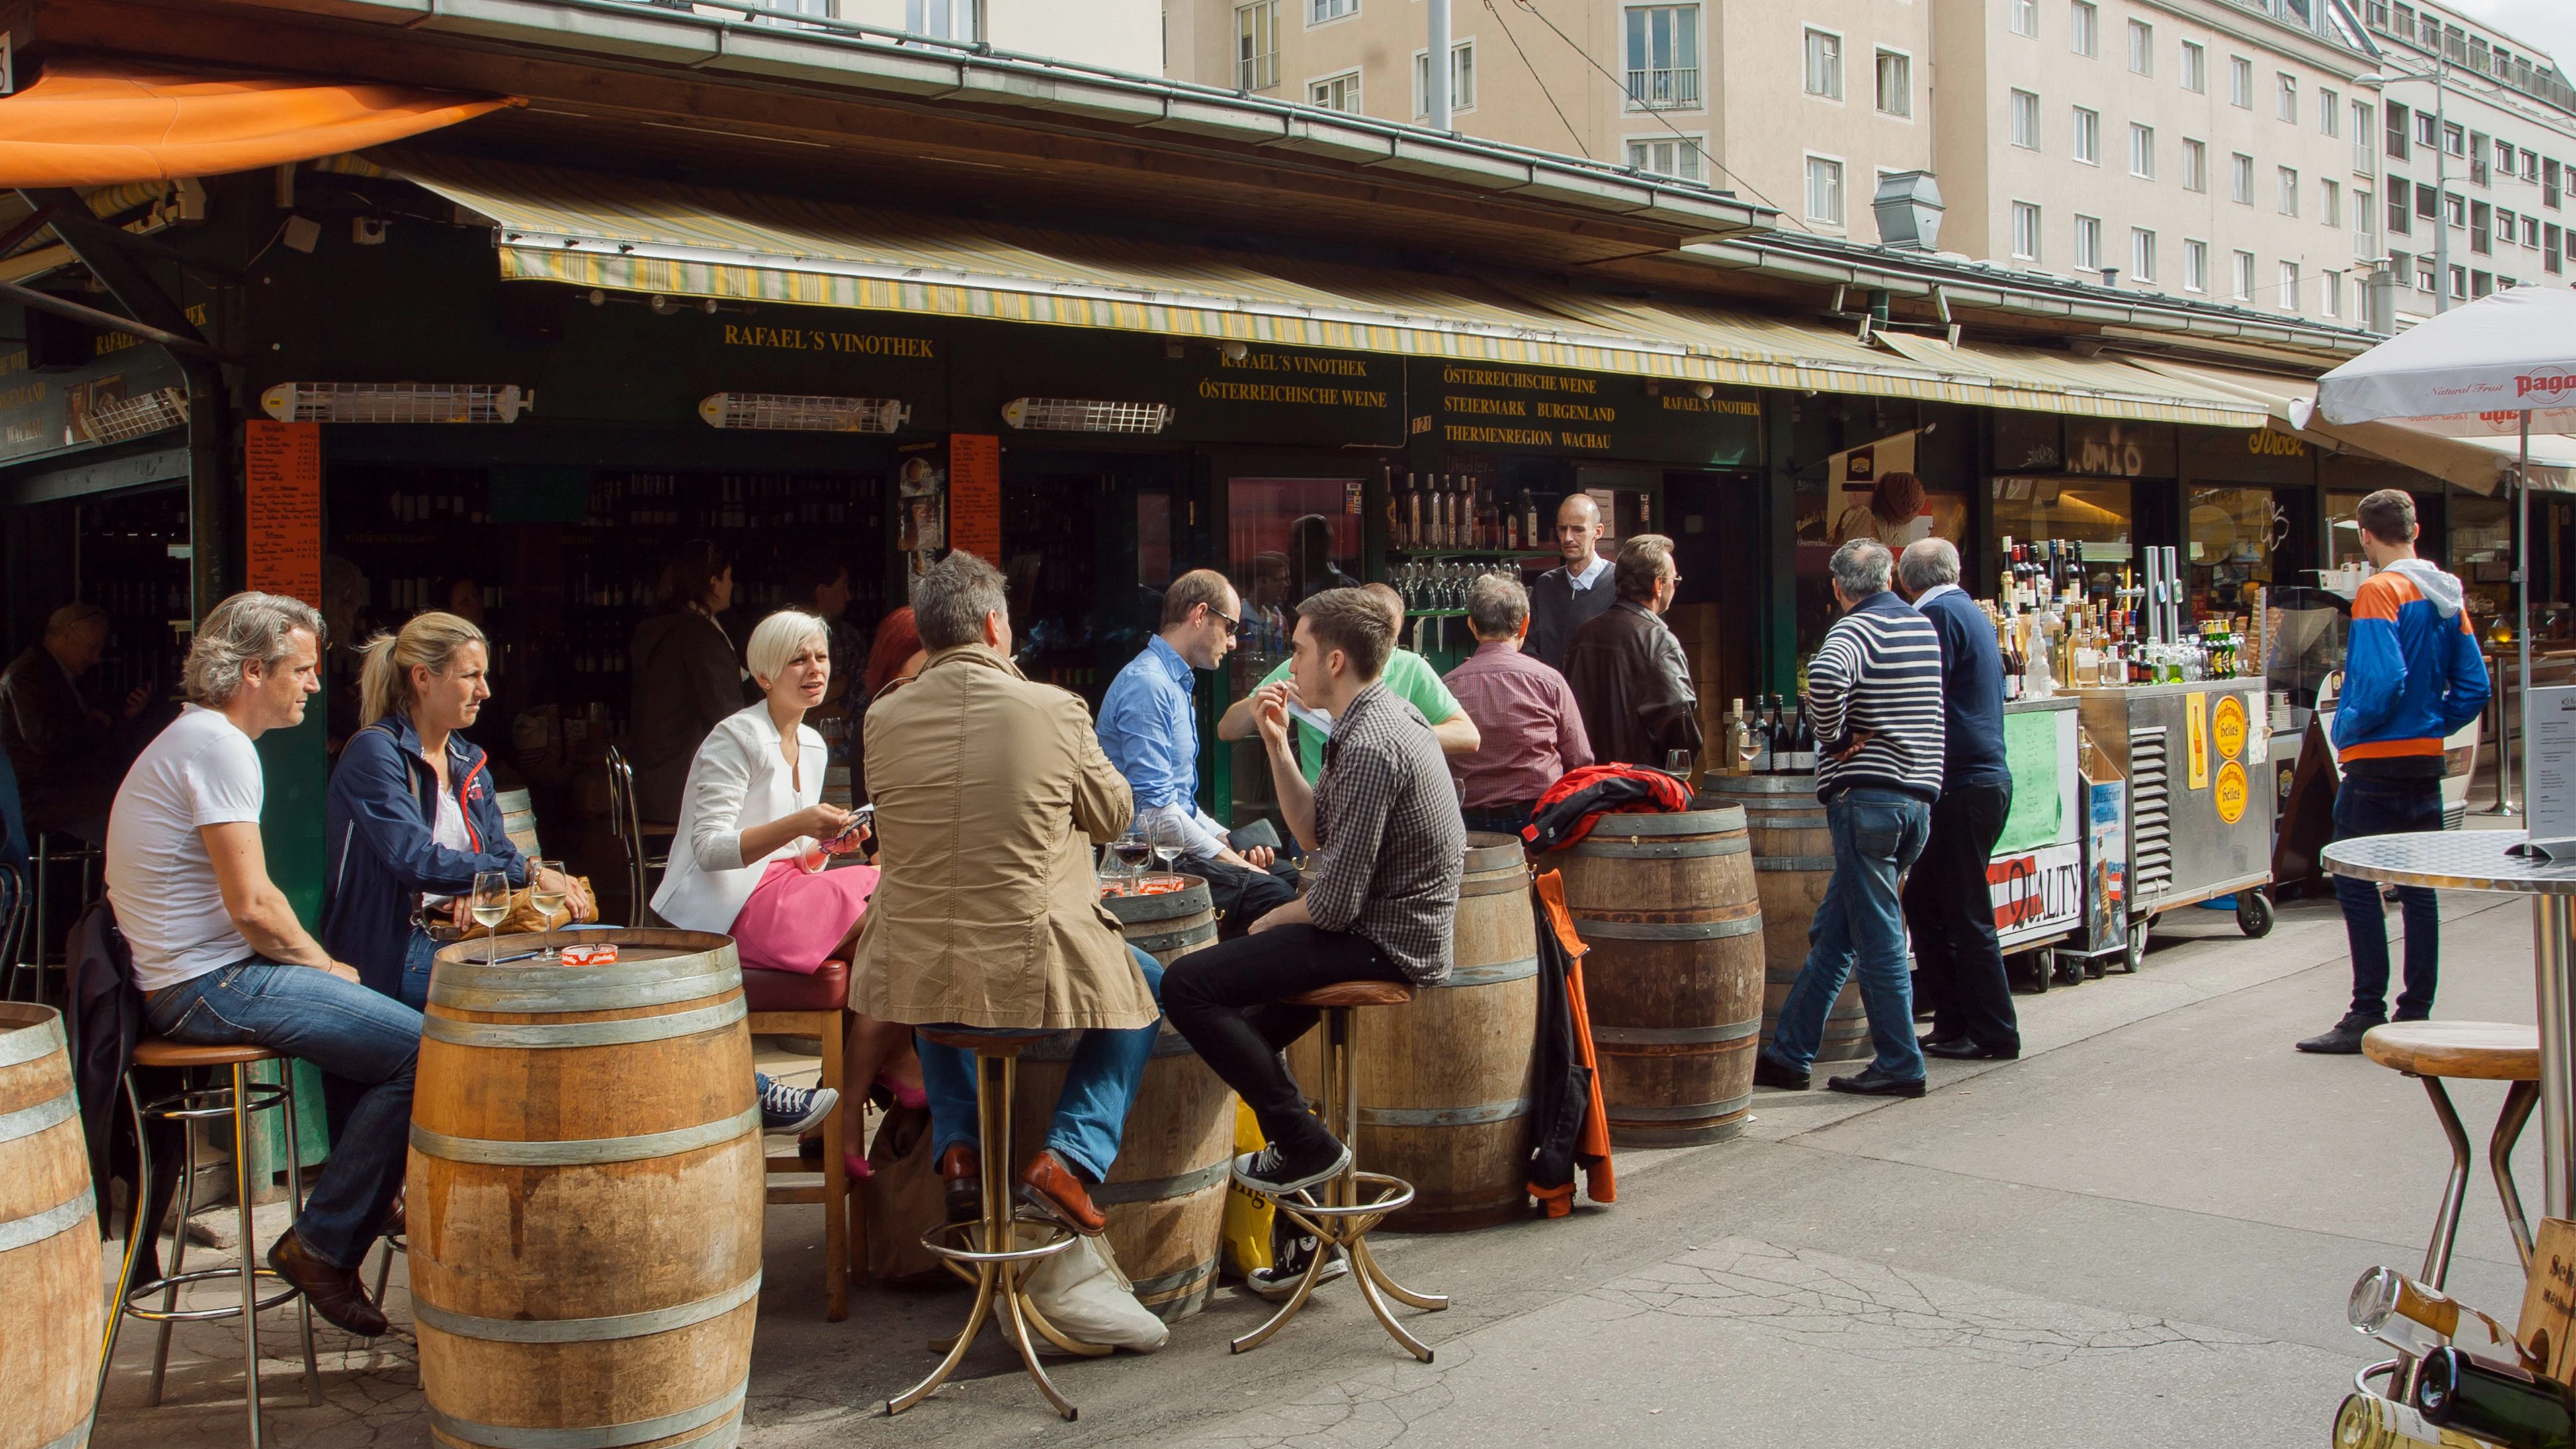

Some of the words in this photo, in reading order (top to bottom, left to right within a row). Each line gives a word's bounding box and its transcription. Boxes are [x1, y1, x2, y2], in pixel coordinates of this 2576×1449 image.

[830, 333, 933, 357] VINOTHEK
[1295, 357, 1367, 376] VINOTHEK
[1443, 365, 1557, 390] ÖSTERREICHISCHE
[1559, 376, 1597, 394] WEINE
[1342, 390, 1387, 408] WEINE
[2425, 384, 2471, 397] Natural
[2473, 382, 2505, 393] Fruit
[1444, 396, 1525, 416] STEIERMARK
[1537, 402, 1615, 421] BURGENLAND
[1711, 400, 1760, 416] VINOTHEK
[1413, 416, 1432, 433] 121
[1445, 425, 1553, 445] THERMENREGION
[1562, 432, 1611, 449] WACHAU
